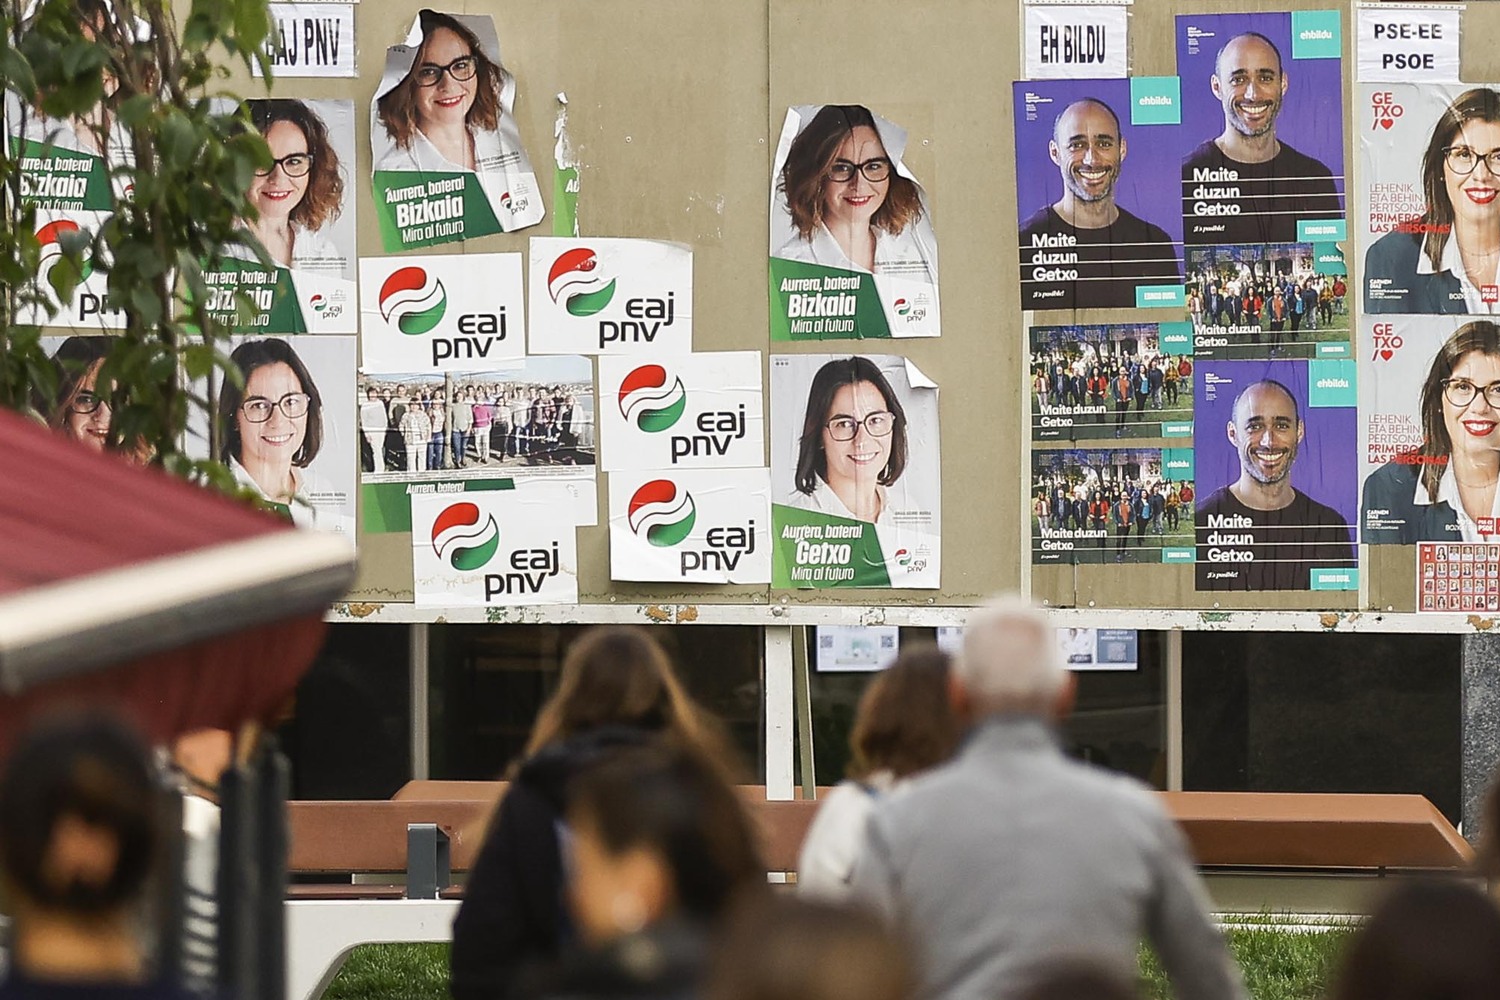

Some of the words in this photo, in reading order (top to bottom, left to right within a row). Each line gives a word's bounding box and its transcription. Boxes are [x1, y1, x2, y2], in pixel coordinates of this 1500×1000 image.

[1374, 24, 1442, 39] PSE-EE
[304, 18, 340, 66] PNV
[1040, 25, 1059, 64] EH
[1064, 25, 1106, 64] BILDU
[1382, 54, 1434, 69] PSOE
[1372, 105, 1404, 118] TXO
[1193, 167, 1238, 182] Maite
[385, 186, 427, 204] Aurrera,
[428, 176, 464, 194] batera!
[1194, 185, 1240, 199] duzun
[1370, 184, 1414, 192] LEHENIK
[396, 195, 464, 228] Bizkaia
[1194, 202, 1240, 216] Getxo
[1370, 214, 1421, 222] PRIMERO
[1032, 233, 1076, 248] Maite
[1032, 250, 1078, 264] duzun
[1032, 267, 1078, 282] Getxo
[780, 277, 822, 292] Aurrera,
[824, 276, 860, 291] batera!
[626, 292, 674, 326] eaj
[788, 293, 856, 318] Bizkaia
[458, 306, 506, 340] eaj
[791, 320, 812, 334] Mira
[814, 320, 823, 333] al
[824, 318, 854, 332] futuro
[1194, 324, 1226, 334] Maite
[1228, 324, 1262, 334] duzun
[599, 320, 660, 348] pnv
[1195, 336, 1228, 348] Getxo
[1373, 336, 1404, 348] TXO
[432, 336, 492, 366] pnv
[1040, 404, 1072, 416] Maite
[1074, 404, 1106, 414] duzun
[697, 404, 746, 438] eaj
[1040, 417, 1073, 428] Getxo
[1368, 414, 1412, 424] LEHENIK
[671, 435, 732, 464] pnv
[1368, 444, 1420, 454] PRIMERO
[1208, 514, 1253, 528] Maite
[707, 520, 755, 554] eaj
[825, 524, 862, 538] batera!
[1040, 528, 1072, 538] Maite
[1074, 528, 1107, 538] duzun
[1208, 531, 1254, 546] duzun
[1041, 540, 1074, 550] Getxo
[510, 541, 558, 576] eaj
[796, 541, 851, 565] Getxo
[1208, 548, 1254, 562] Getxo
[681, 550, 742, 576] pnv
[792, 567, 812, 580] Mira
[814, 567, 823, 580] al
[824, 567, 854, 580] futuro
[485, 572, 546, 601] pnv
